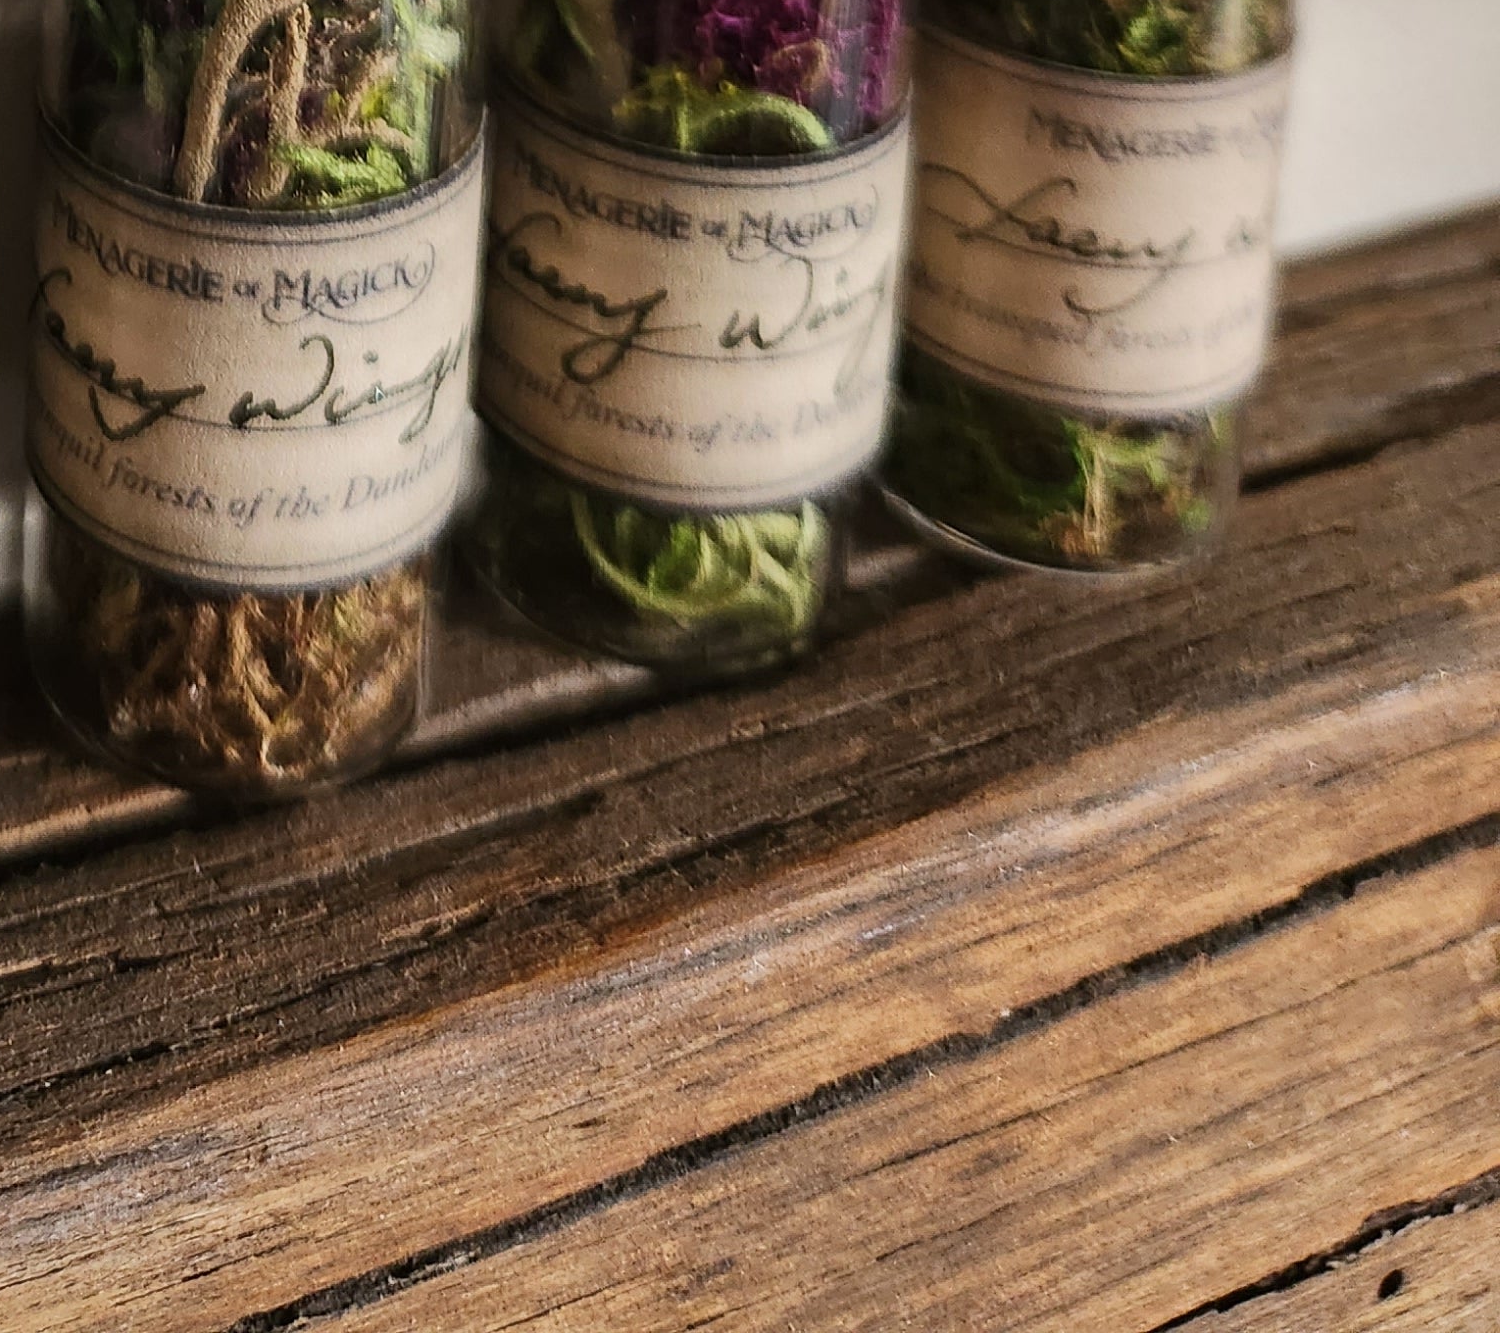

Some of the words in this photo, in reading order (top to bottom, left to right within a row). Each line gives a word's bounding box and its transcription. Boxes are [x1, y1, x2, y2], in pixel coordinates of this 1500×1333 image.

[49, 188, 226, 305] MENAGERIE
[260, 239, 436, 325] MAGICK
[100, 454, 216, 514] forests
[228, 487, 274, 530] of
